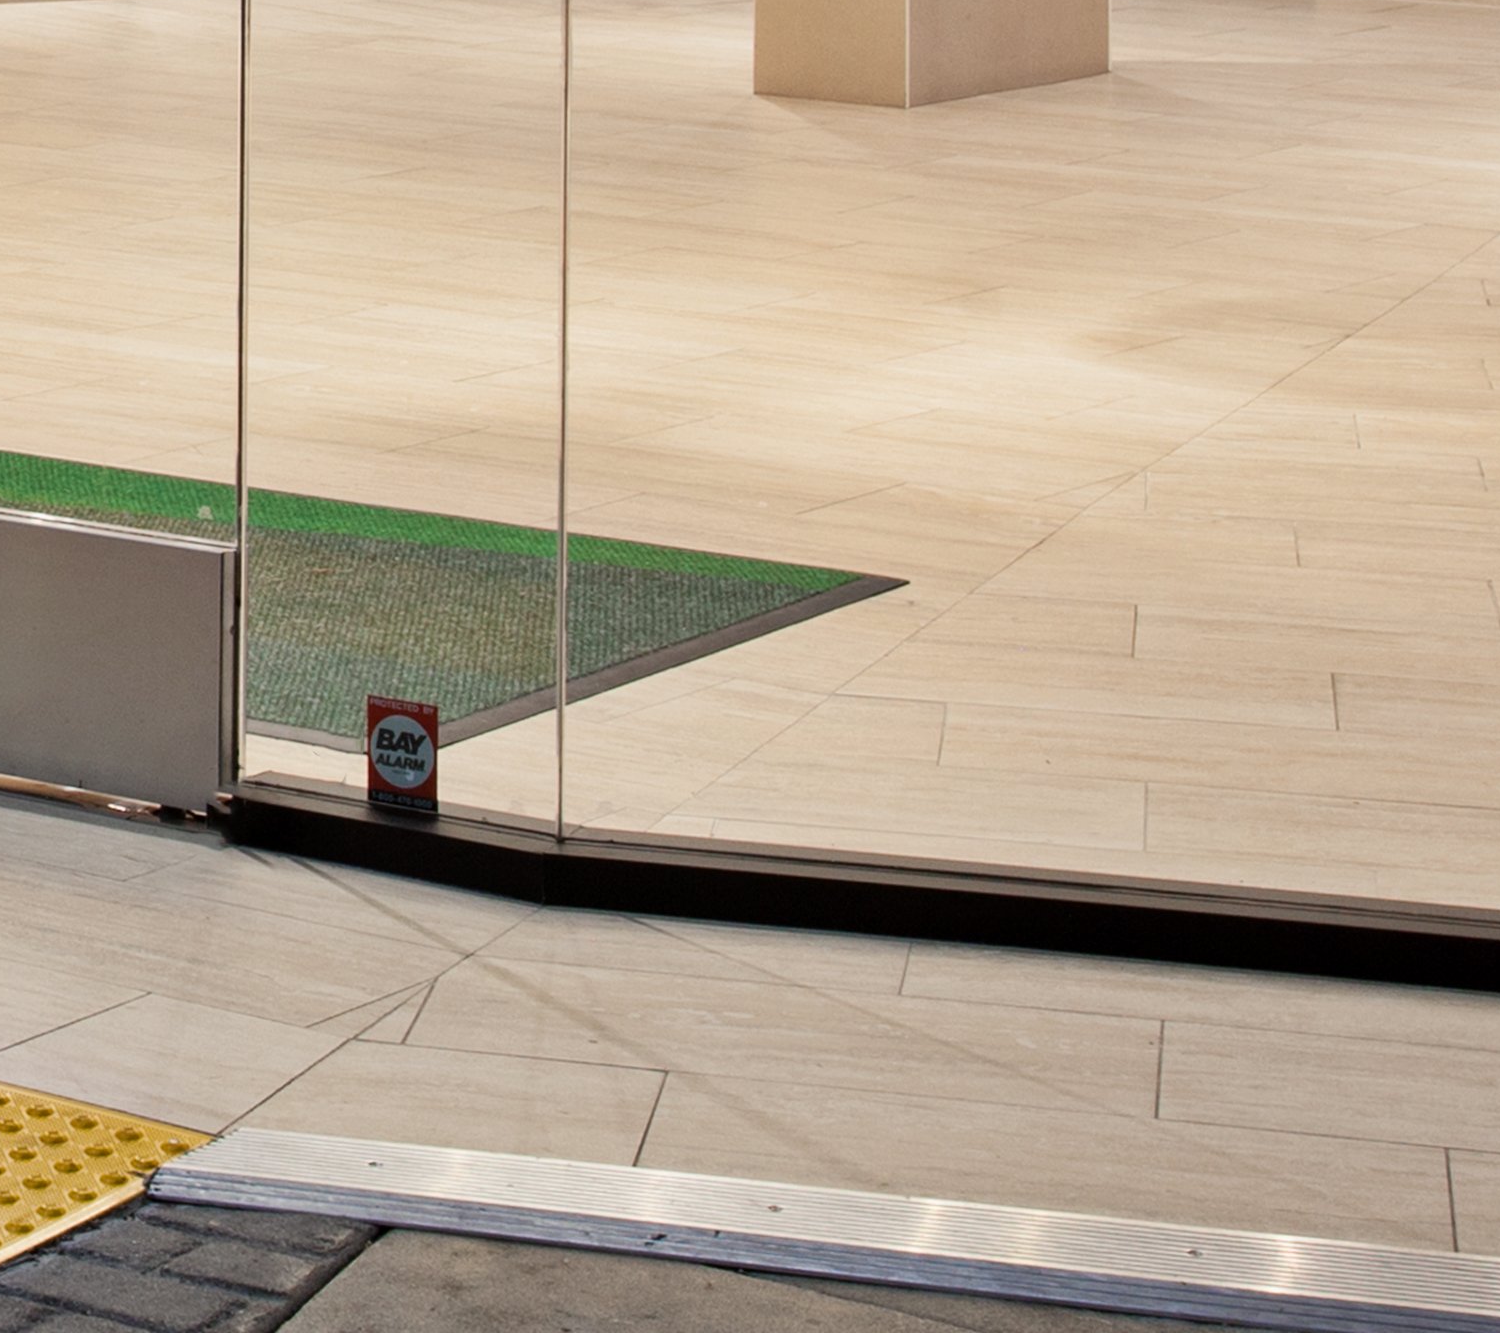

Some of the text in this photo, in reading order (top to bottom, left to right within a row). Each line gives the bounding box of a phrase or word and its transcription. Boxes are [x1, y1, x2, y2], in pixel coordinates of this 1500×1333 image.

[370, 697, 434, 715] PROTECTED BY
[376, 727, 427, 755] BAY
[375, 753, 426, 772] ALARM
